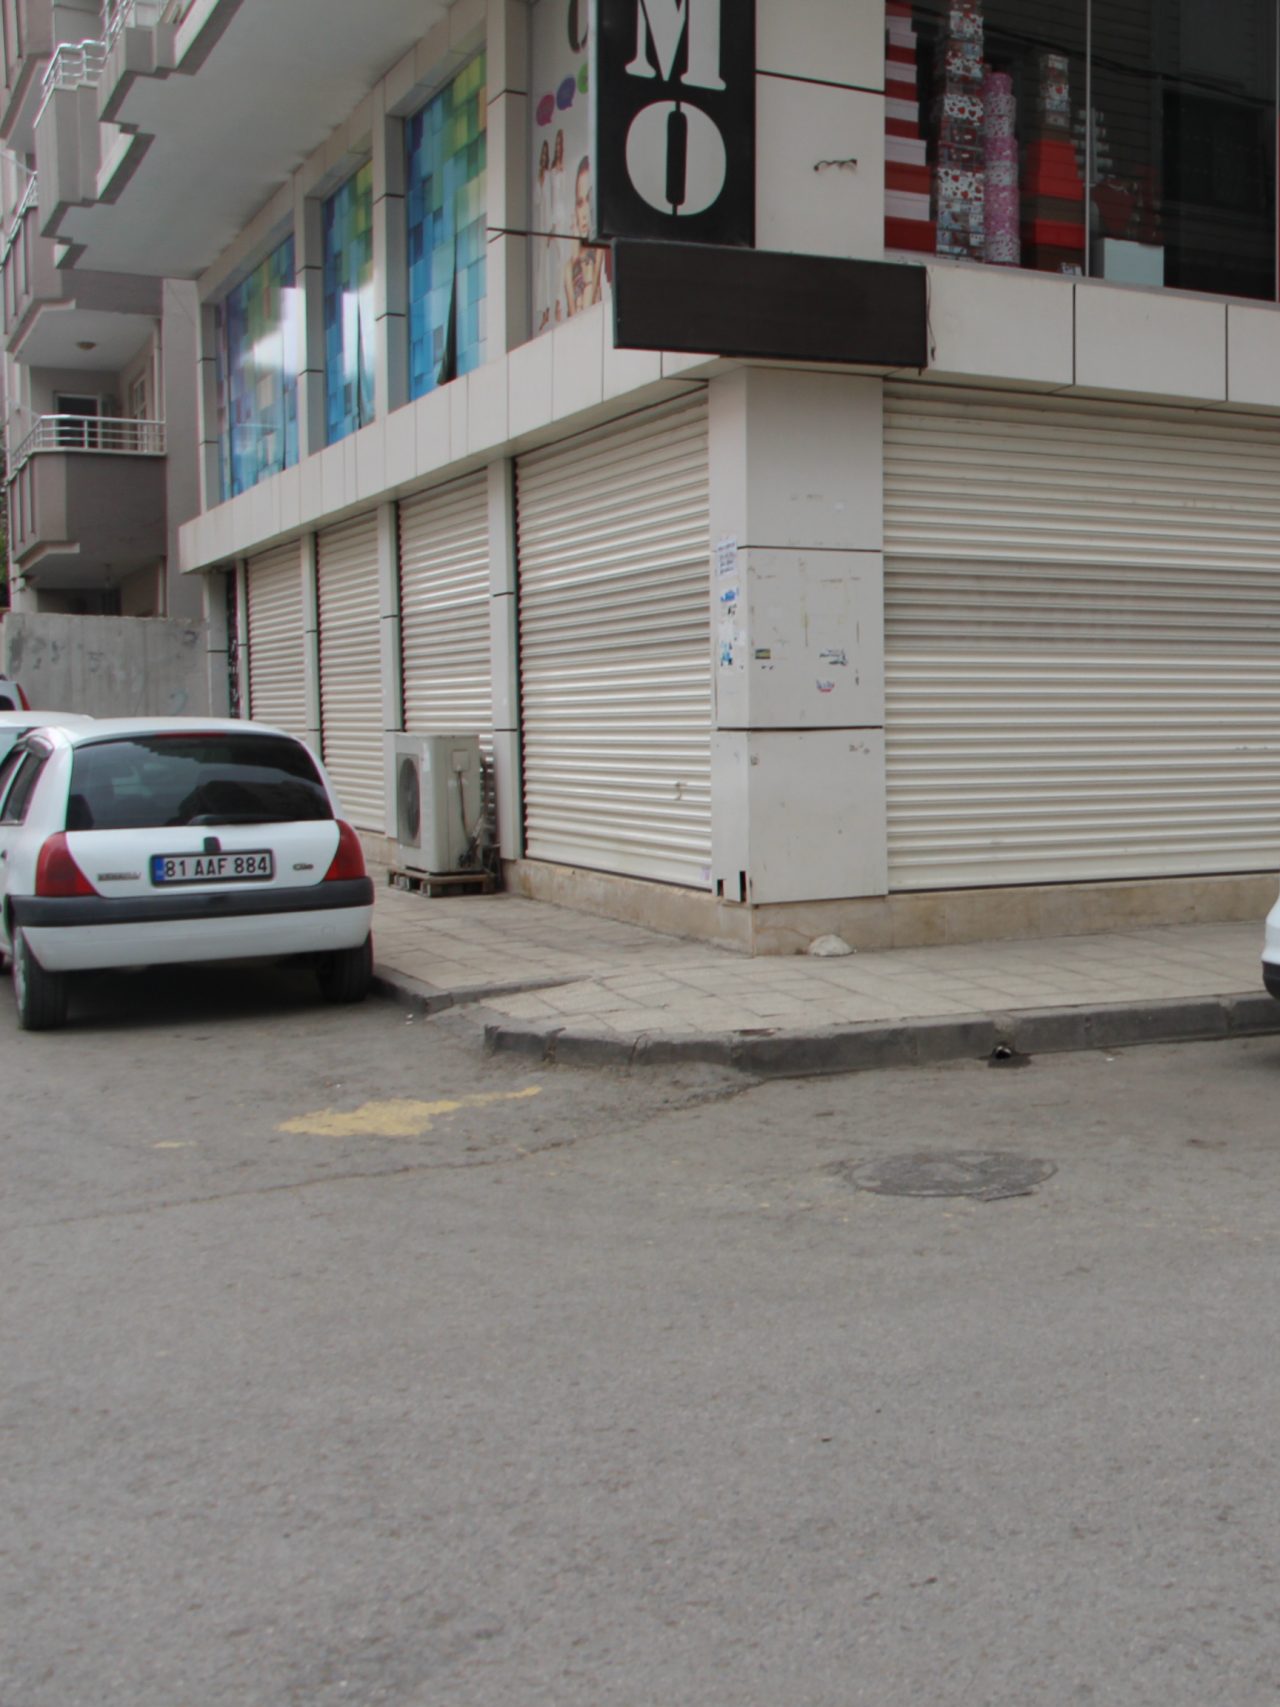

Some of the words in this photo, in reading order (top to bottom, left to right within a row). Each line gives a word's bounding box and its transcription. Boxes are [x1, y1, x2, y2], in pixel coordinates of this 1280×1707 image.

[164, 860, 186, 877] 81
[194, 858, 228, 876] AAF
[234, 856, 267, 874] 884
